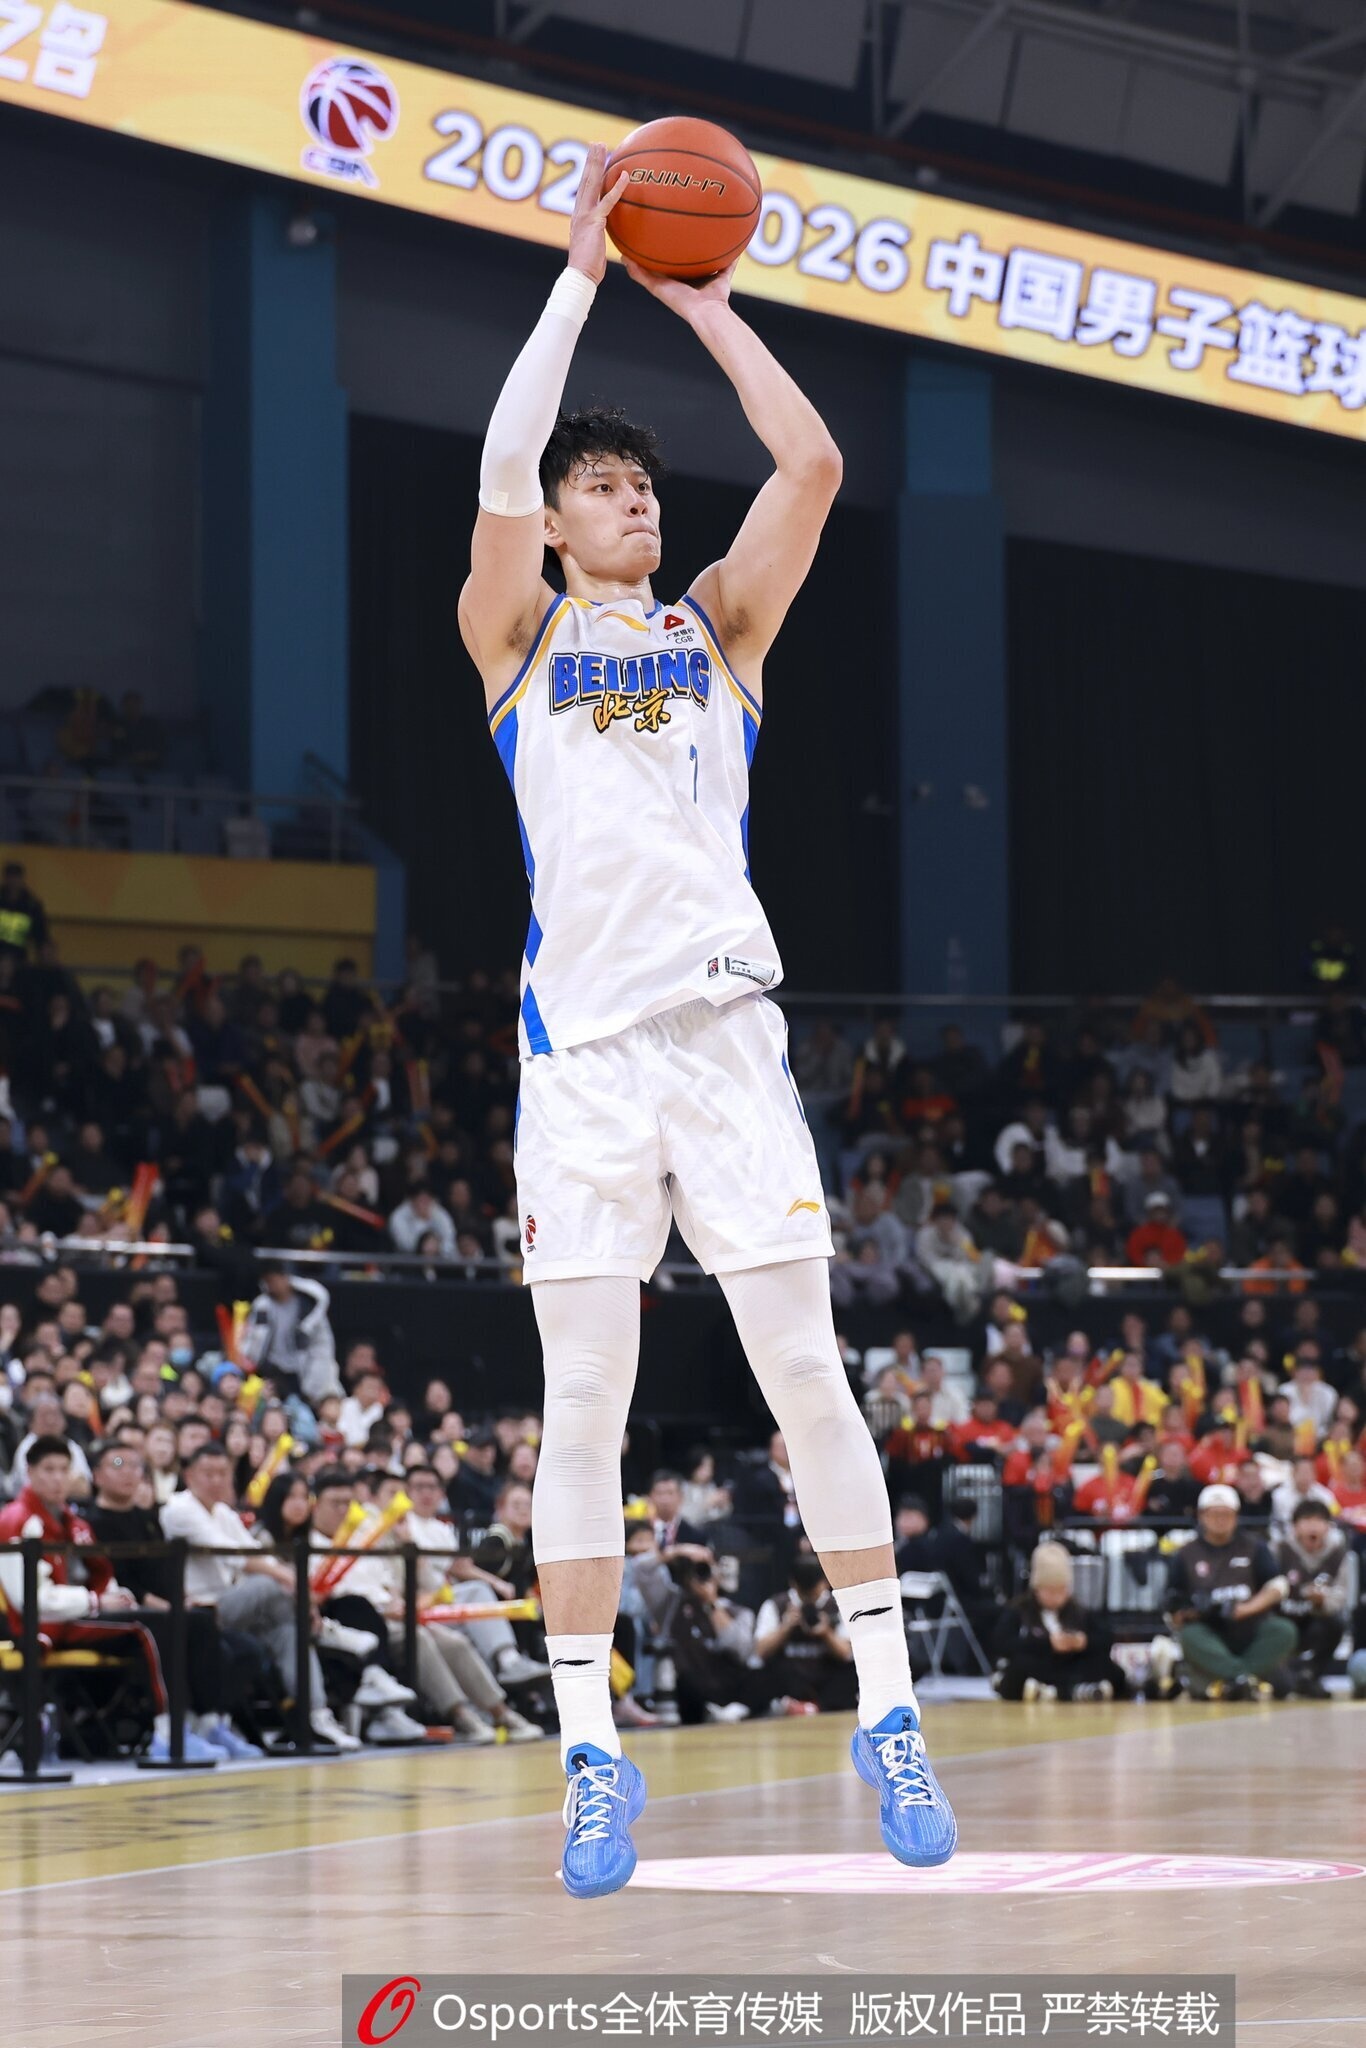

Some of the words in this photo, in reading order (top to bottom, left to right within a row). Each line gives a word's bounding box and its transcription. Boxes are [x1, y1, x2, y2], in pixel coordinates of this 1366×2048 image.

[629, 168, 726, 196] LI-NING
[675, 635, 694, 644] CGB
[549, 648, 711, 715] BEIJING
[593, 688, 671, 733] 北京
